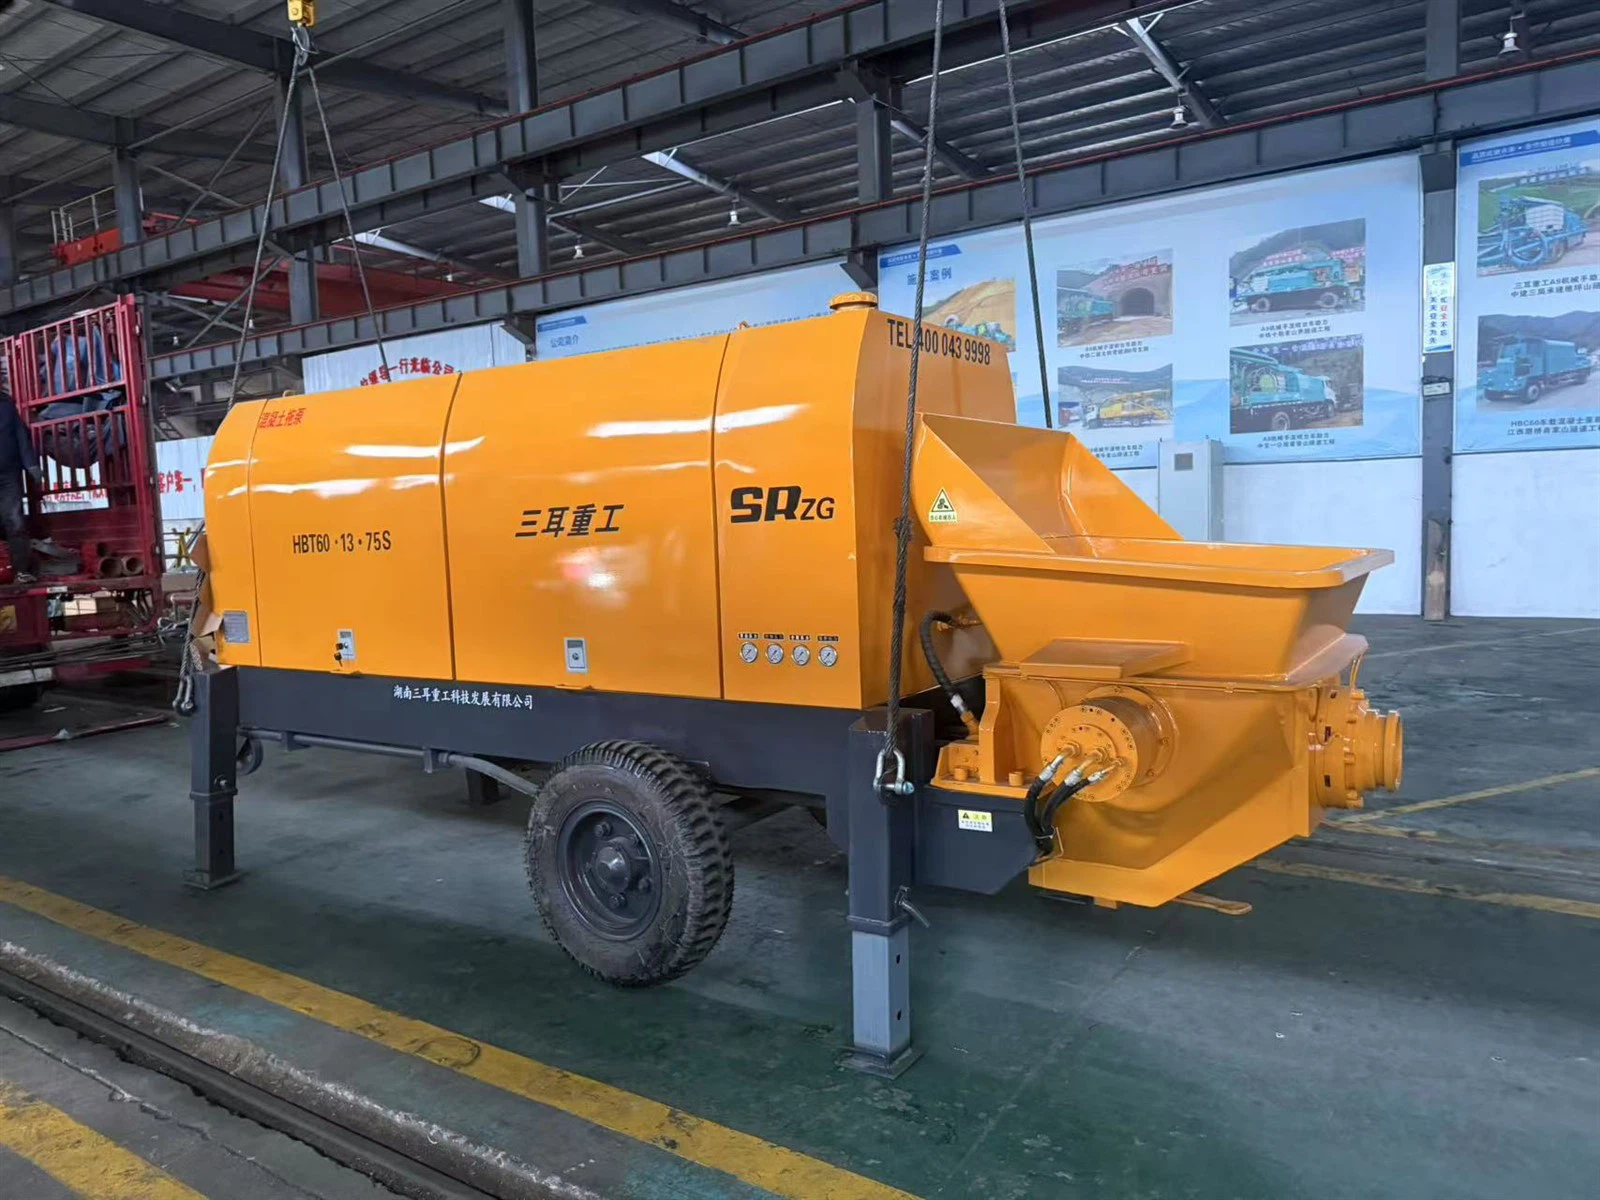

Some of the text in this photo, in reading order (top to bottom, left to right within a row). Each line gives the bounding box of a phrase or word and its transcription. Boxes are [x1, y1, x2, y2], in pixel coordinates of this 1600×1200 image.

[907, 267, 952, 286] 施案例
[887, 318, 914, 349] TEL
[941, 333, 962, 359] 043
[964, 338, 991, 365] 9998
[259, 408, 306, 428] 混凝土拖泵
[514, 503, 625, 538] 三耳重工
[393, 684, 534, 710] 湖南三耳重工科技发展有限公司
